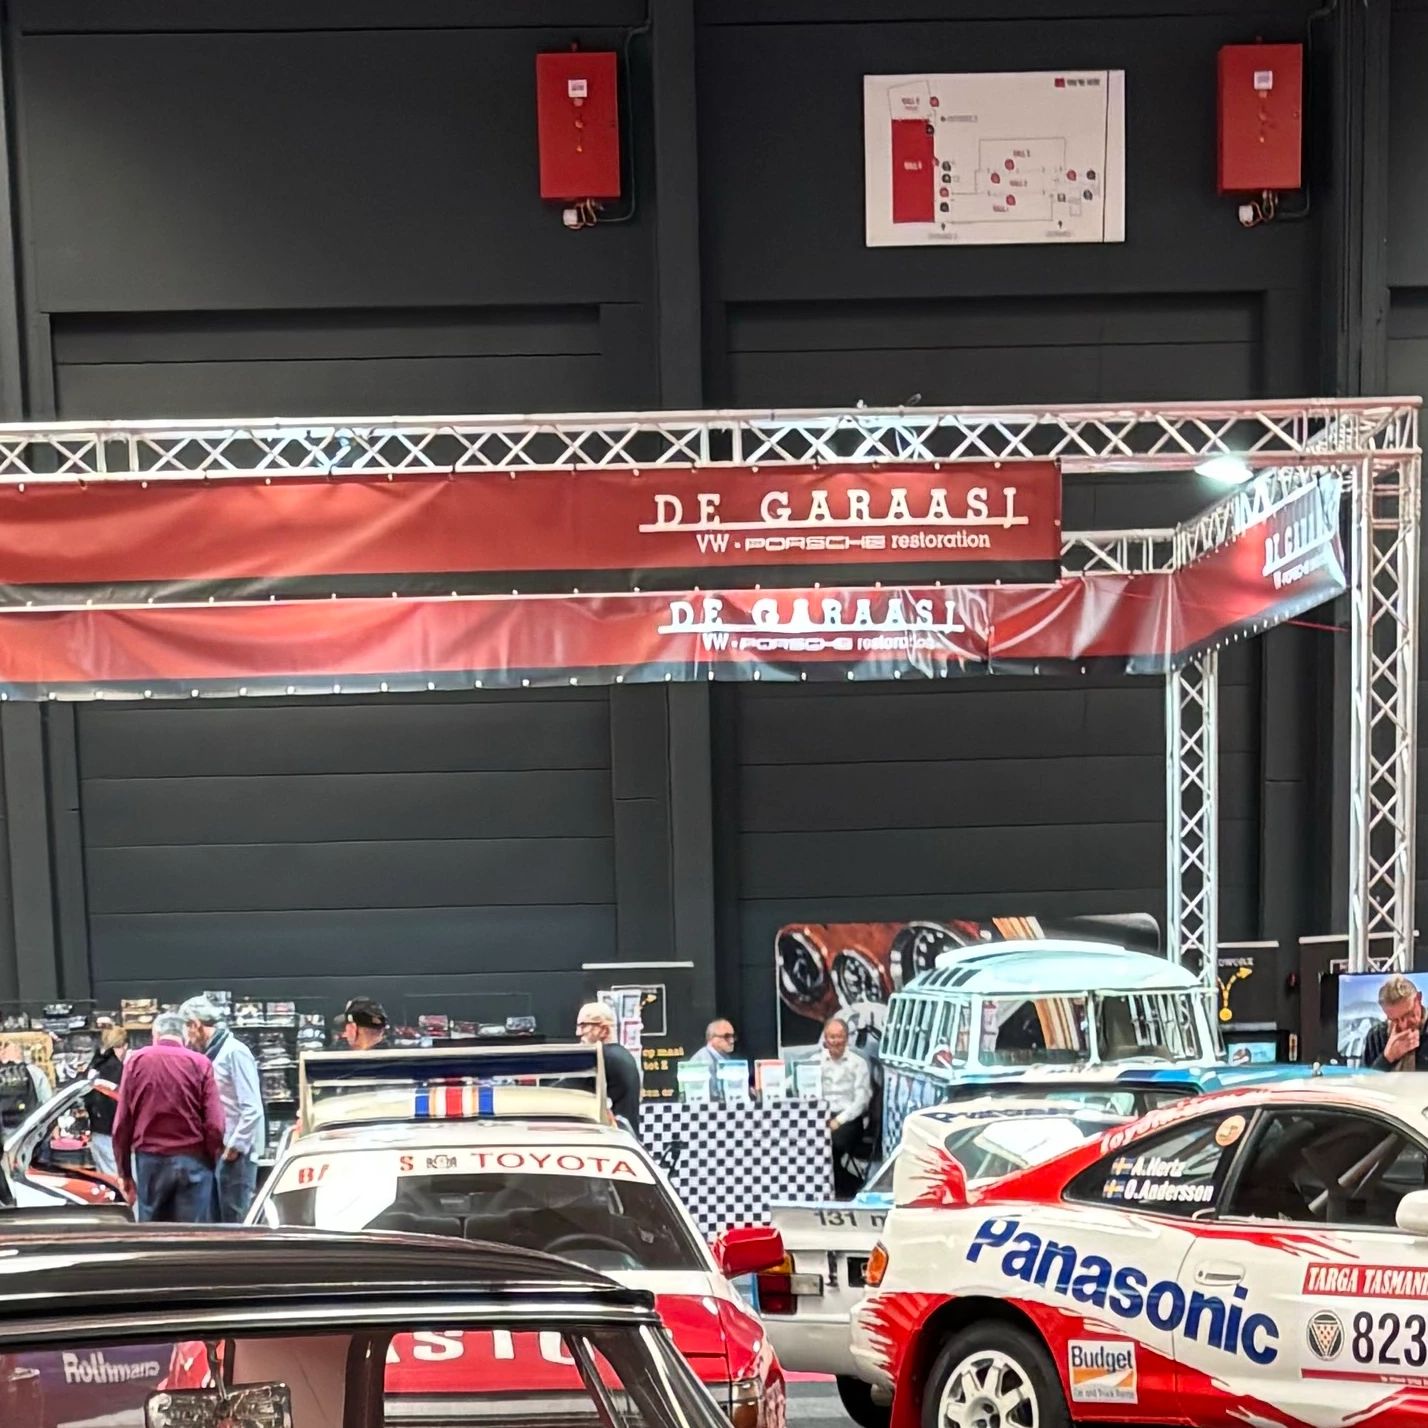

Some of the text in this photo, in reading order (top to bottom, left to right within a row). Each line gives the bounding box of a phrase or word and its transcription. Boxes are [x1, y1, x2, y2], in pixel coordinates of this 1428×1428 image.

[653, 493, 721, 526] DE
[696, 531, 990, 553] VW PORSCHE restoration
[670, 598, 722, 627] DE
[702, 633, 729, 651] VW
[470, 1152, 638, 1177] TOYOTA
[1131, 1157, 1188, 1177] A.Hertz
[814, 1210, 857, 1227] 131
[966, 1216, 1280, 1365] Panasonic
[1308, 1267, 1359, 1292] TARGA
[1352, 1310, 1428, 1367] 823
[1071, 1346, 1133, 1373] Budget
